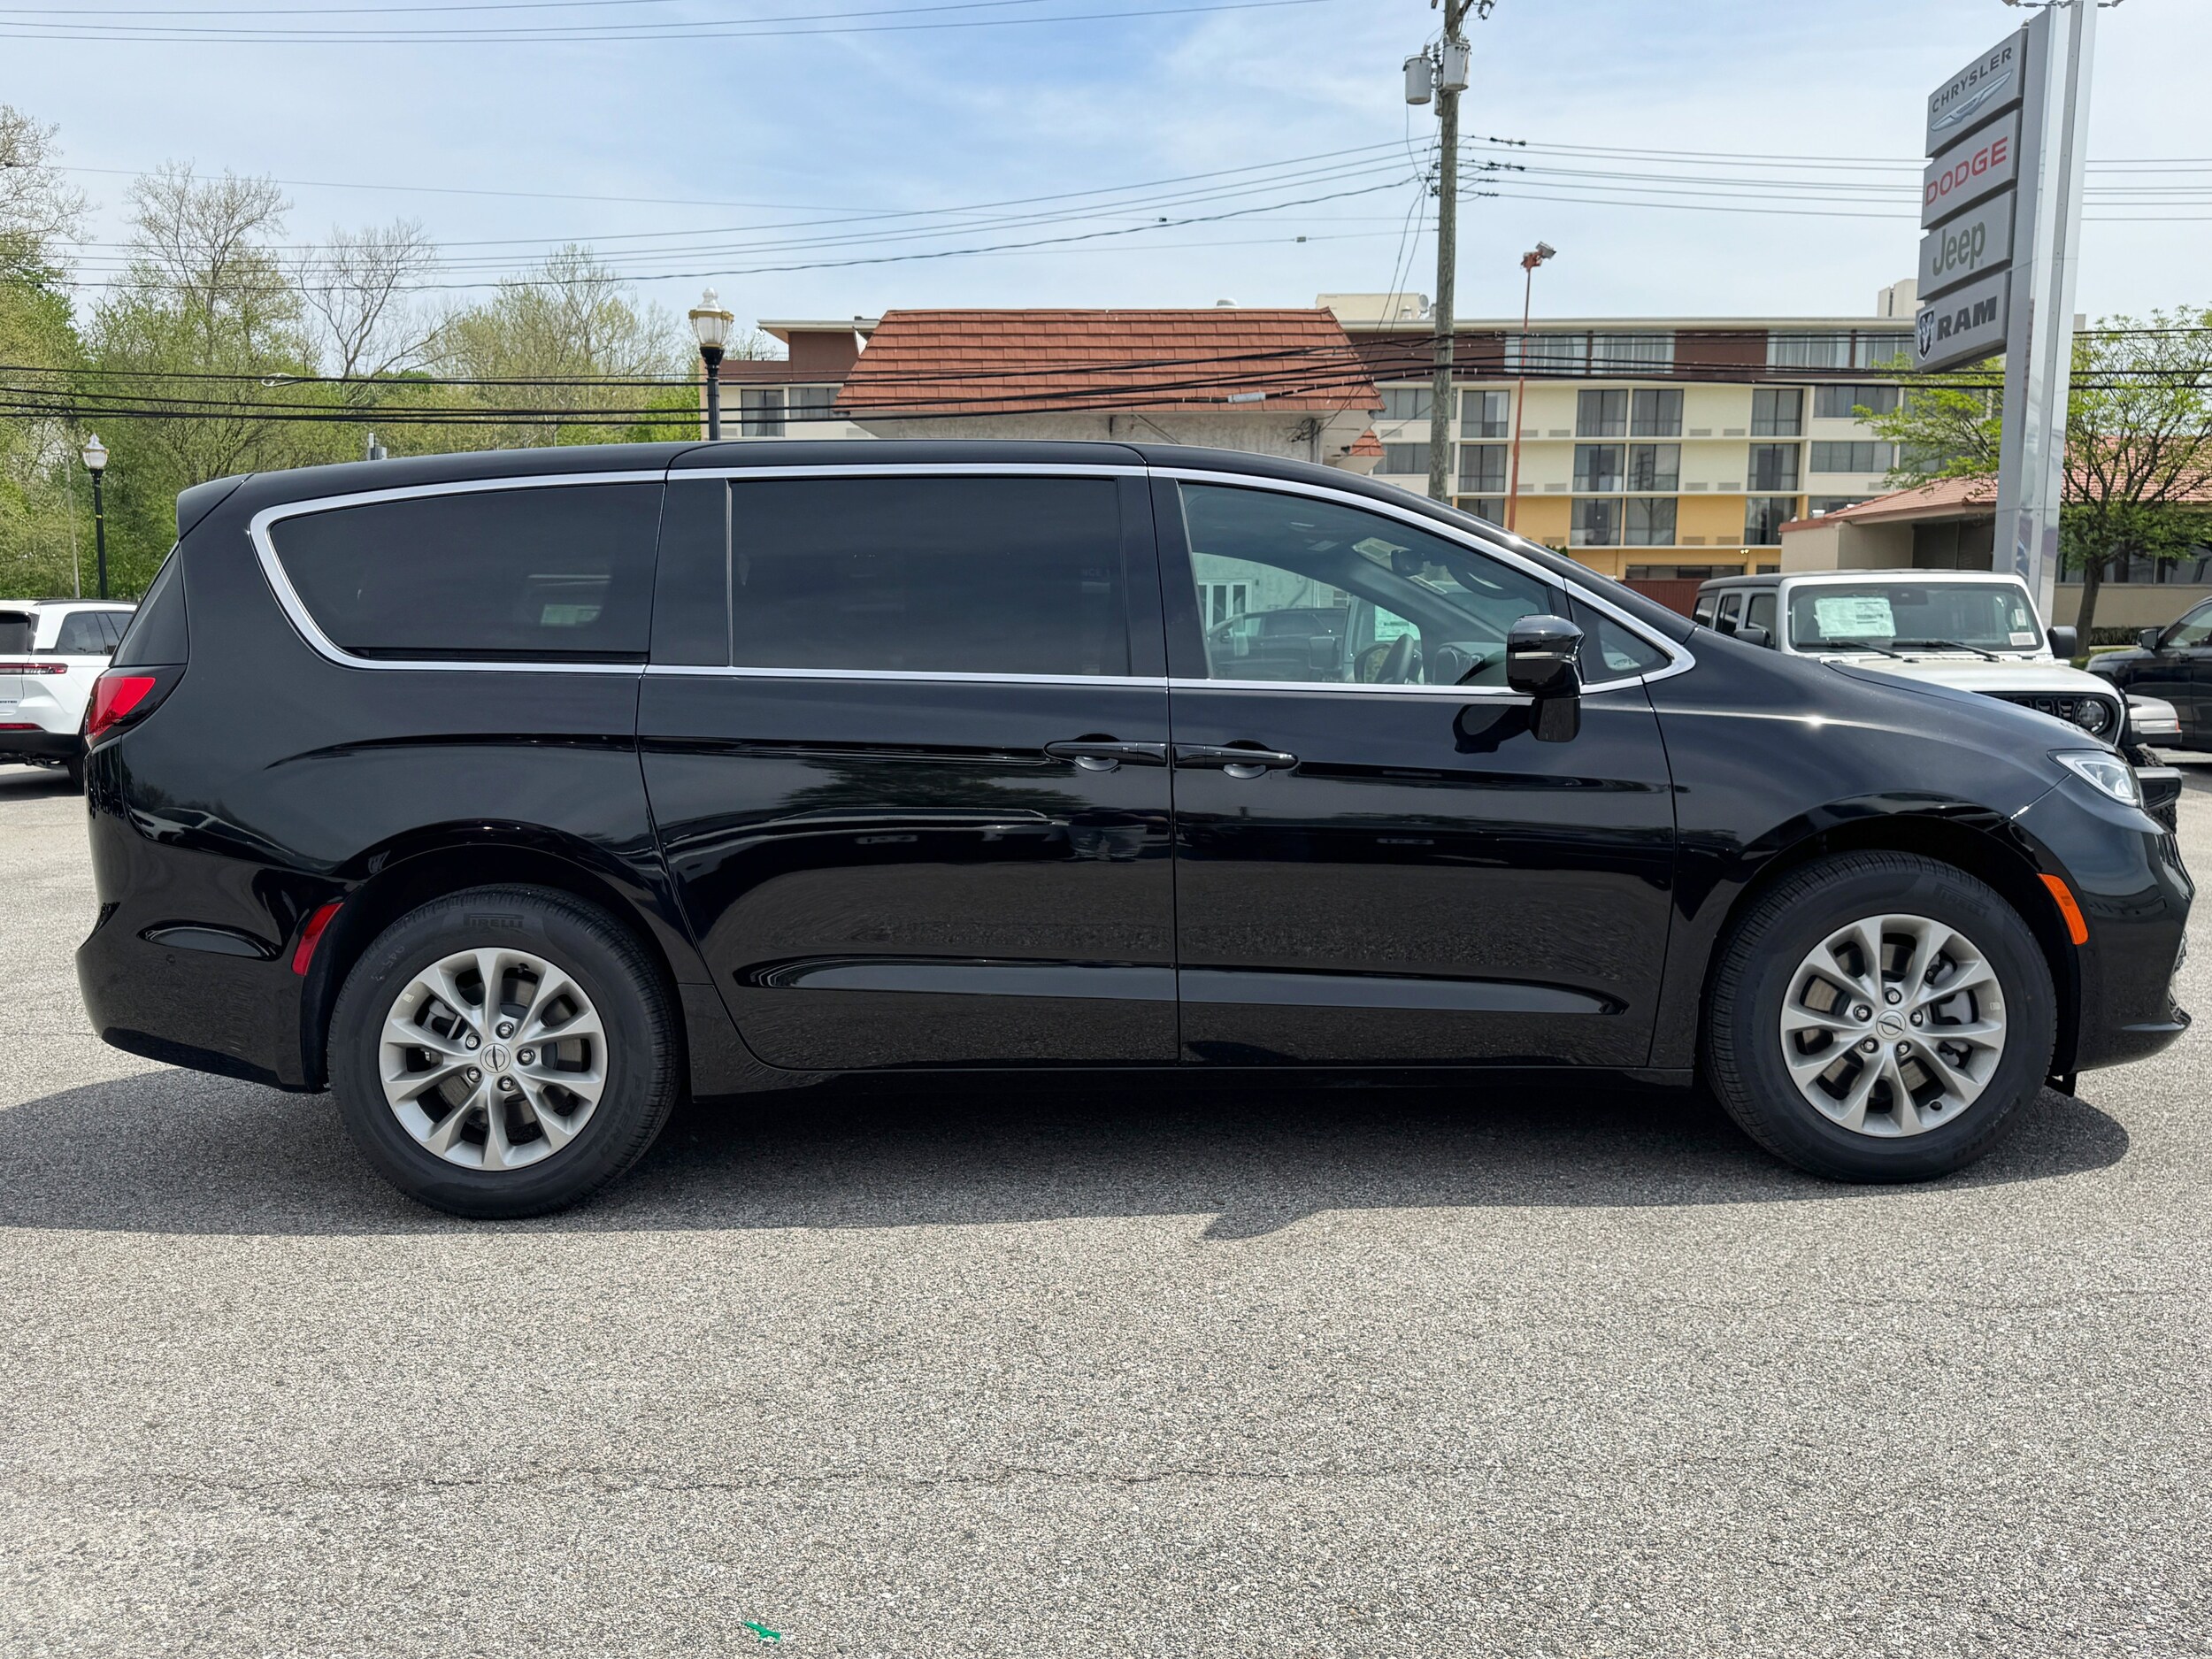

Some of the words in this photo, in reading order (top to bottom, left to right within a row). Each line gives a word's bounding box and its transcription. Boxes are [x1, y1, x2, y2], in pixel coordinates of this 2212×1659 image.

[1932, 47, 2013, 113] CHRYSLER
[1925, 136, 2008, 207] DODGE
[1932, 221, 1986, 277] Jeep
[1937, 296, 1998, 342] RAM
[464, 913, 525, 929] PIRELLI
